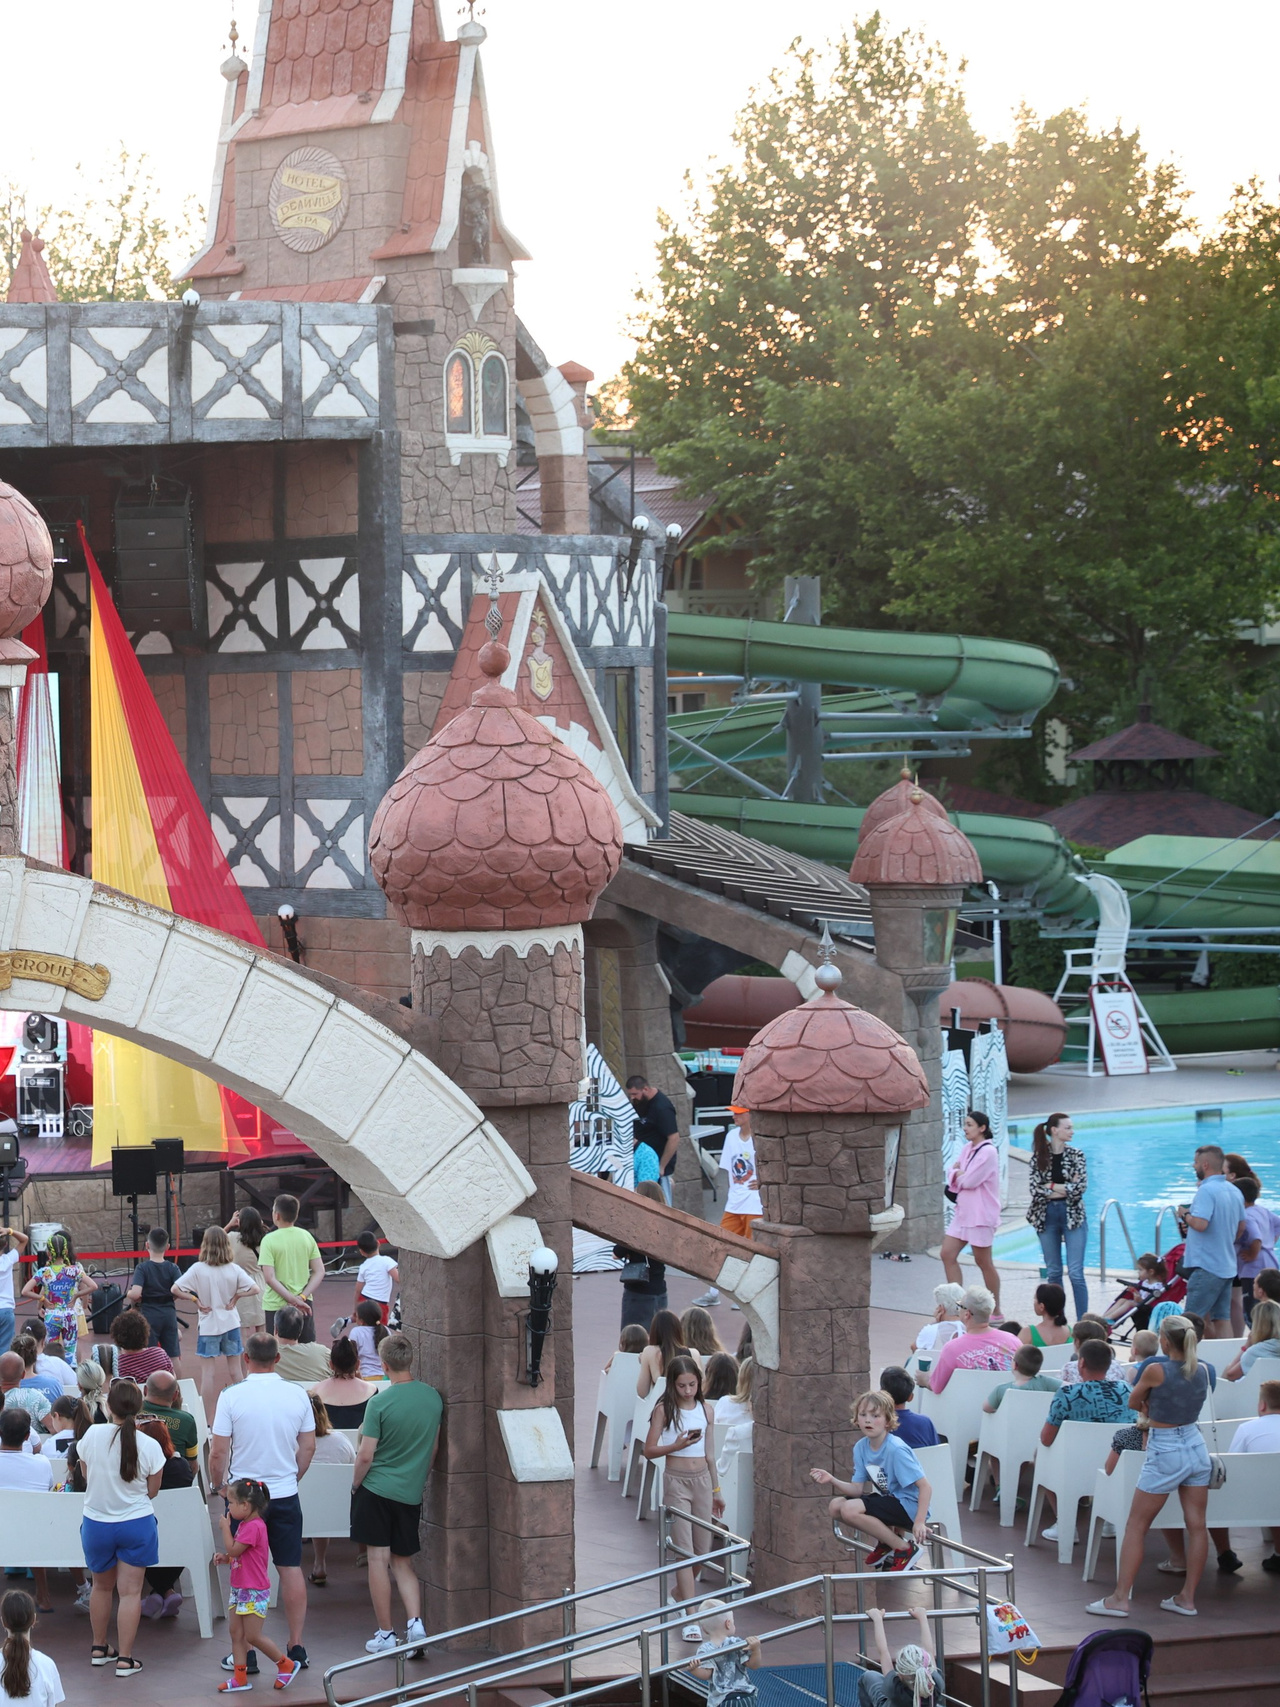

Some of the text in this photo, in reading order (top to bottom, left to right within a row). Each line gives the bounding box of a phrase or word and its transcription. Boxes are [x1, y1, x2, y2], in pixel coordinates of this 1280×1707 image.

[286, 173, 326, 189] HOTEL
[296, 216, 318, 225] SPA
[11, 957, 74, 979] GROUP
